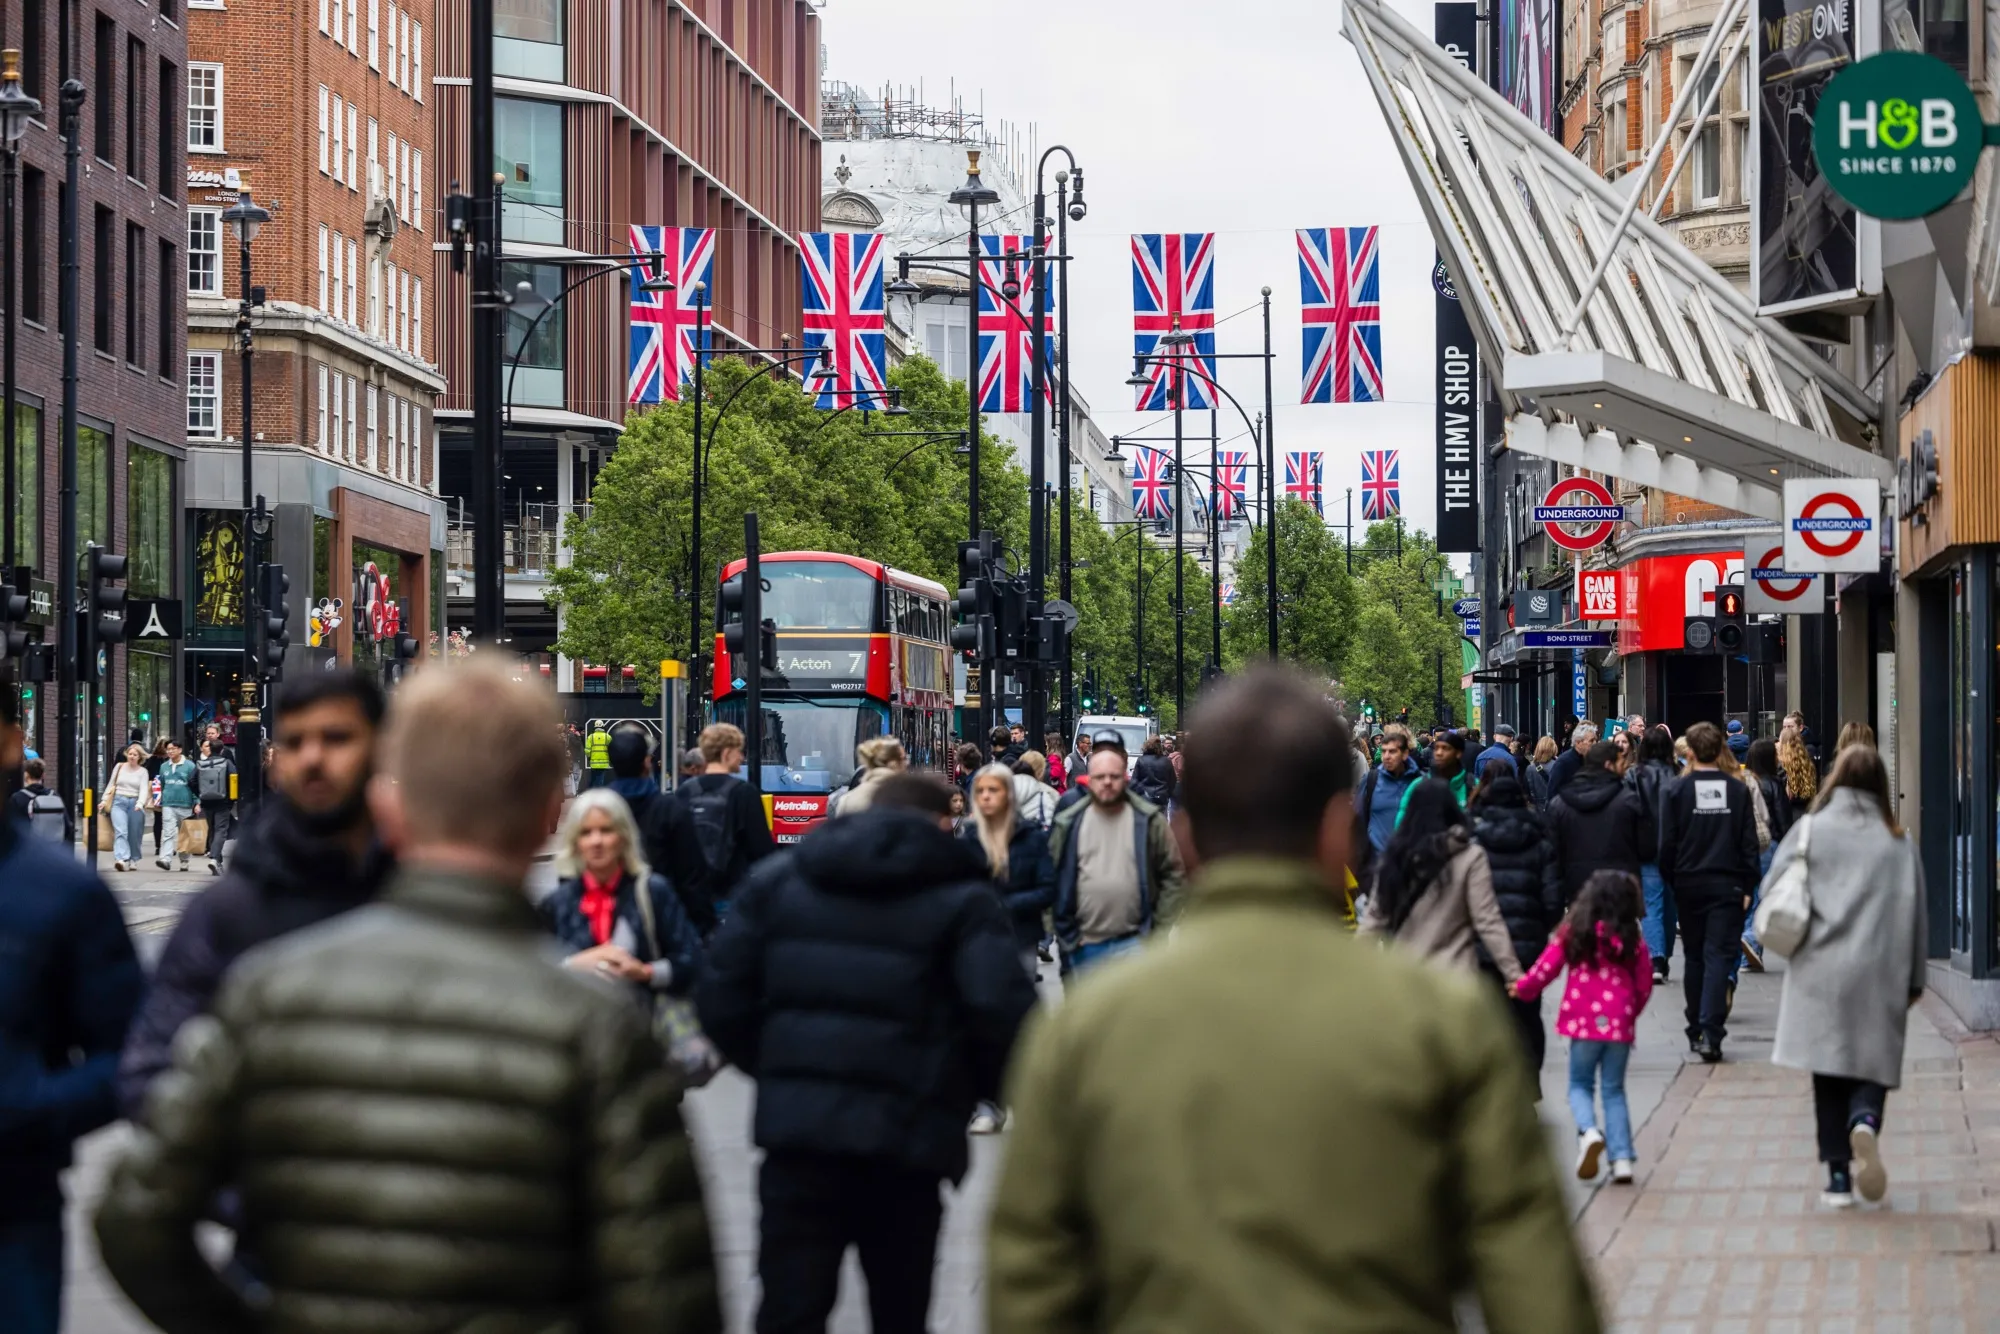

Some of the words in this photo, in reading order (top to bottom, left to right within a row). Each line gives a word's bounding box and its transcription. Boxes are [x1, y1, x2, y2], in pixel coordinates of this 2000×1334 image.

[1838, 97, 1958, 150] H&B
[1840, 156, 1902, 175] SINCE
[1910, 156, 1957, 174] 1870
[1444, 345, 1470, 405] SHOP
[1444, 411, 1470, 462] HMV
[1444, 468, 1470, 512] THE
[1538, 508, 1620, 519] UNDERGROUND
[1796, 520, 1868, 530] UNDERGROUND
[1584, 575, 1616, 593] CAN
[789, 657, 832, 670] Acton
[848, 653, 863, 674] 7
[1575, 663, 1586, 723] MONEY
[774, 800, 819, 811] Metroline
